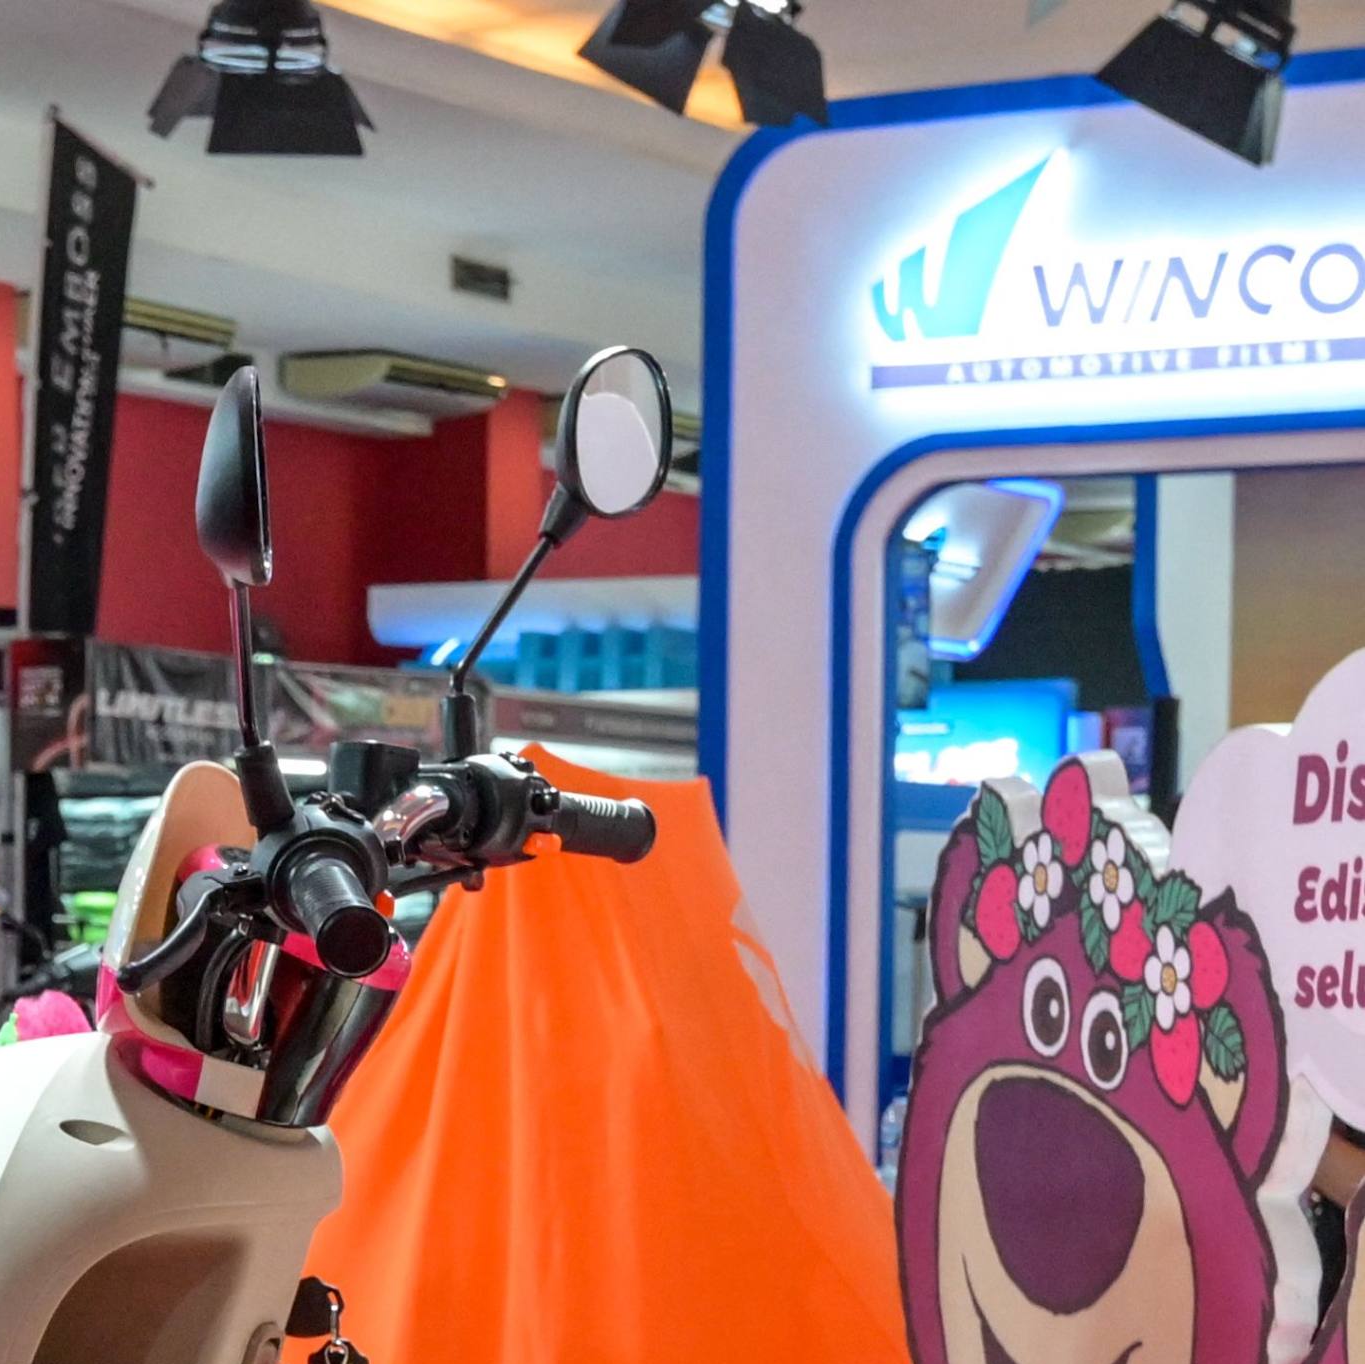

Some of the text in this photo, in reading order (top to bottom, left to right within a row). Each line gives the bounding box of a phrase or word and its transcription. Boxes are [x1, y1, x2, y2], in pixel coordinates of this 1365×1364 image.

[946, 339, 1332, 384] AUTOMOTIVE FILMS
[1294, 856, 1365, 923] Edi
